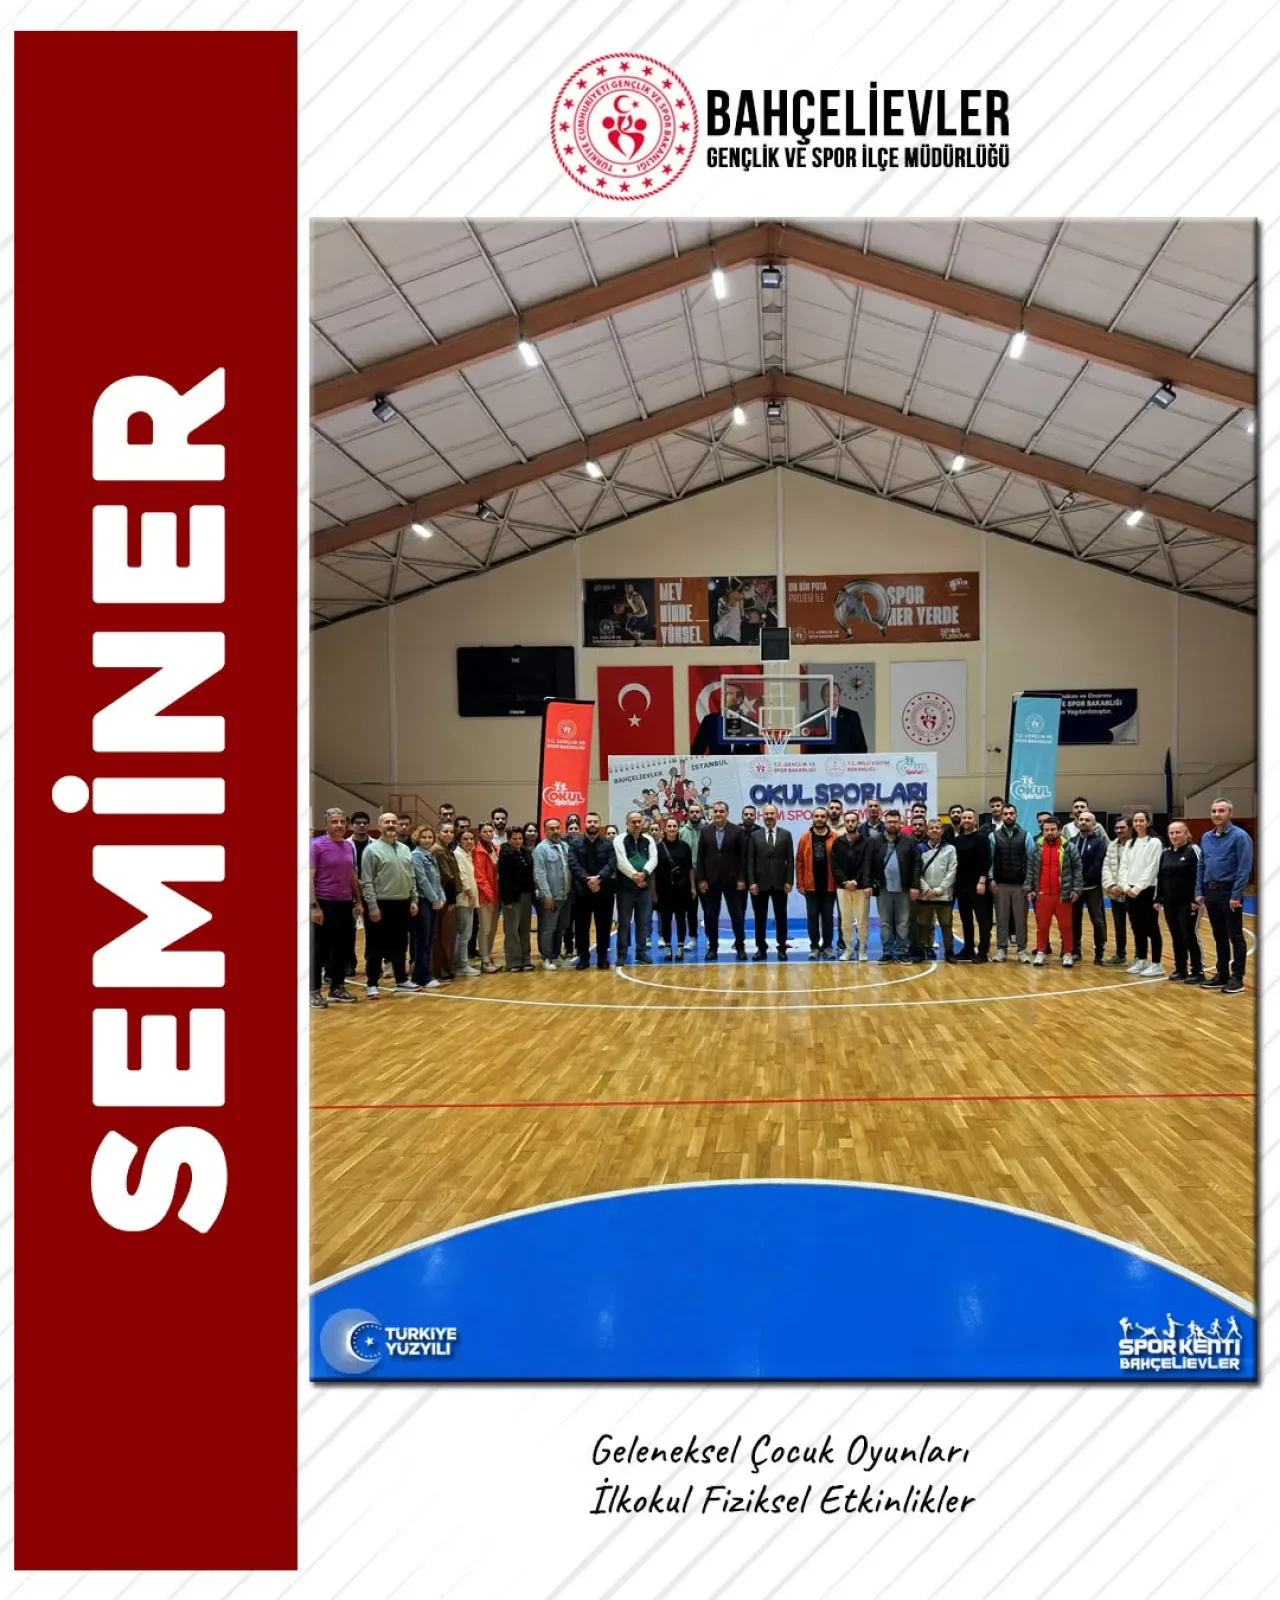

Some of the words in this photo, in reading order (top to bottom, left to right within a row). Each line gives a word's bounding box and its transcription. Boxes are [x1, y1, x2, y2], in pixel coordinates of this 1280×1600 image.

[887, 586, 925, 605] SPOR
[916, 605, 960, 626] YERDE
[1087, 698, 1122, 707] BAKANLIĞI
[691, 759, 729, 772] İSTANBUL
[549, 790, 585, 803] OKUL
[749, 783, 813, 804] OKUL
[814, 782, 928, 804] SPORLARI
[1015, 785, 1052, 797] OKUL
[757, 809, 785, 821] HM
[787, 809, 814, 821] SPO
